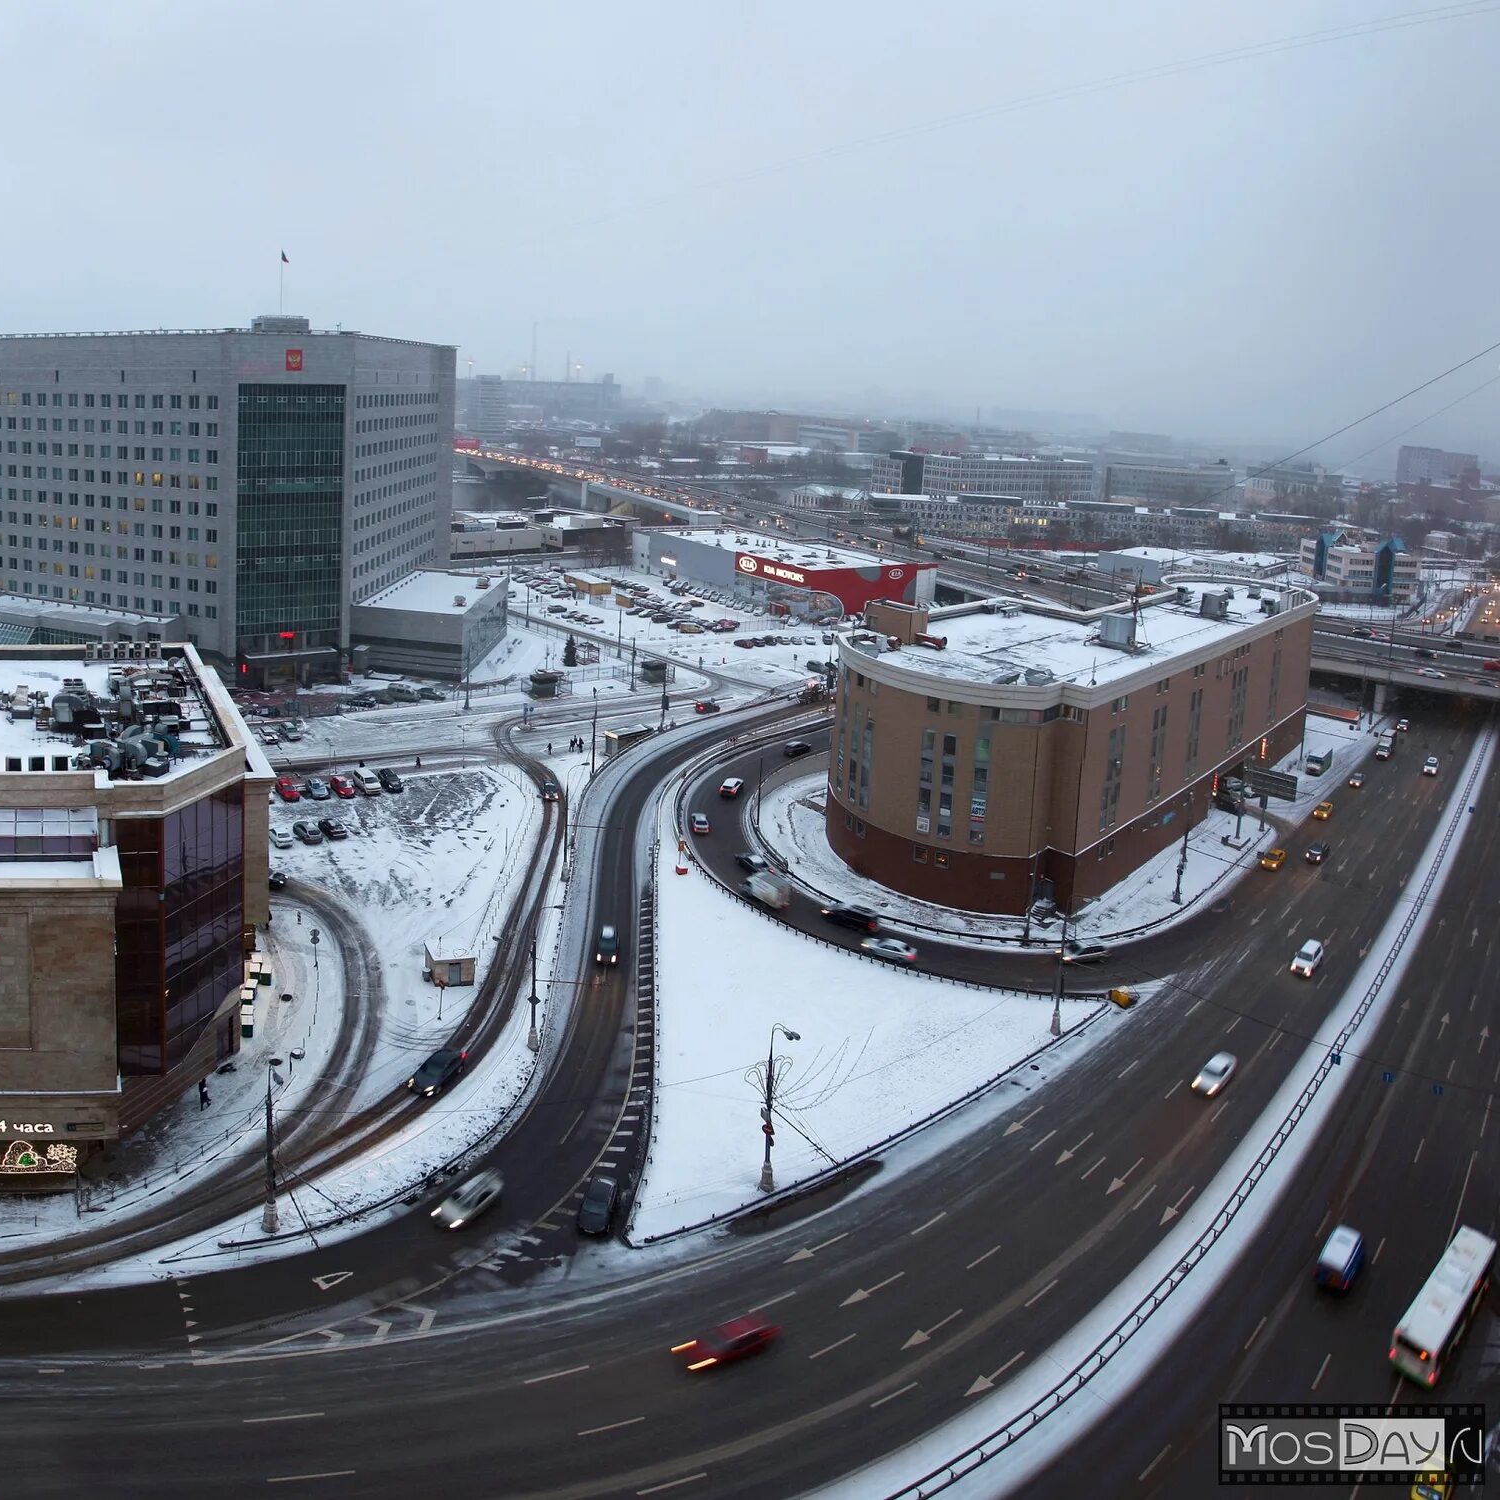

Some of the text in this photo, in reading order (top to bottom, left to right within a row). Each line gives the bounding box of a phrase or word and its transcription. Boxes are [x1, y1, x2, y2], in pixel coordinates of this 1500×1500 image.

[764, 565, 804, 583] KIA MOTORS
[971, 807, 985, 815] АВТО
[12, 1121, 54, 1134] часа
